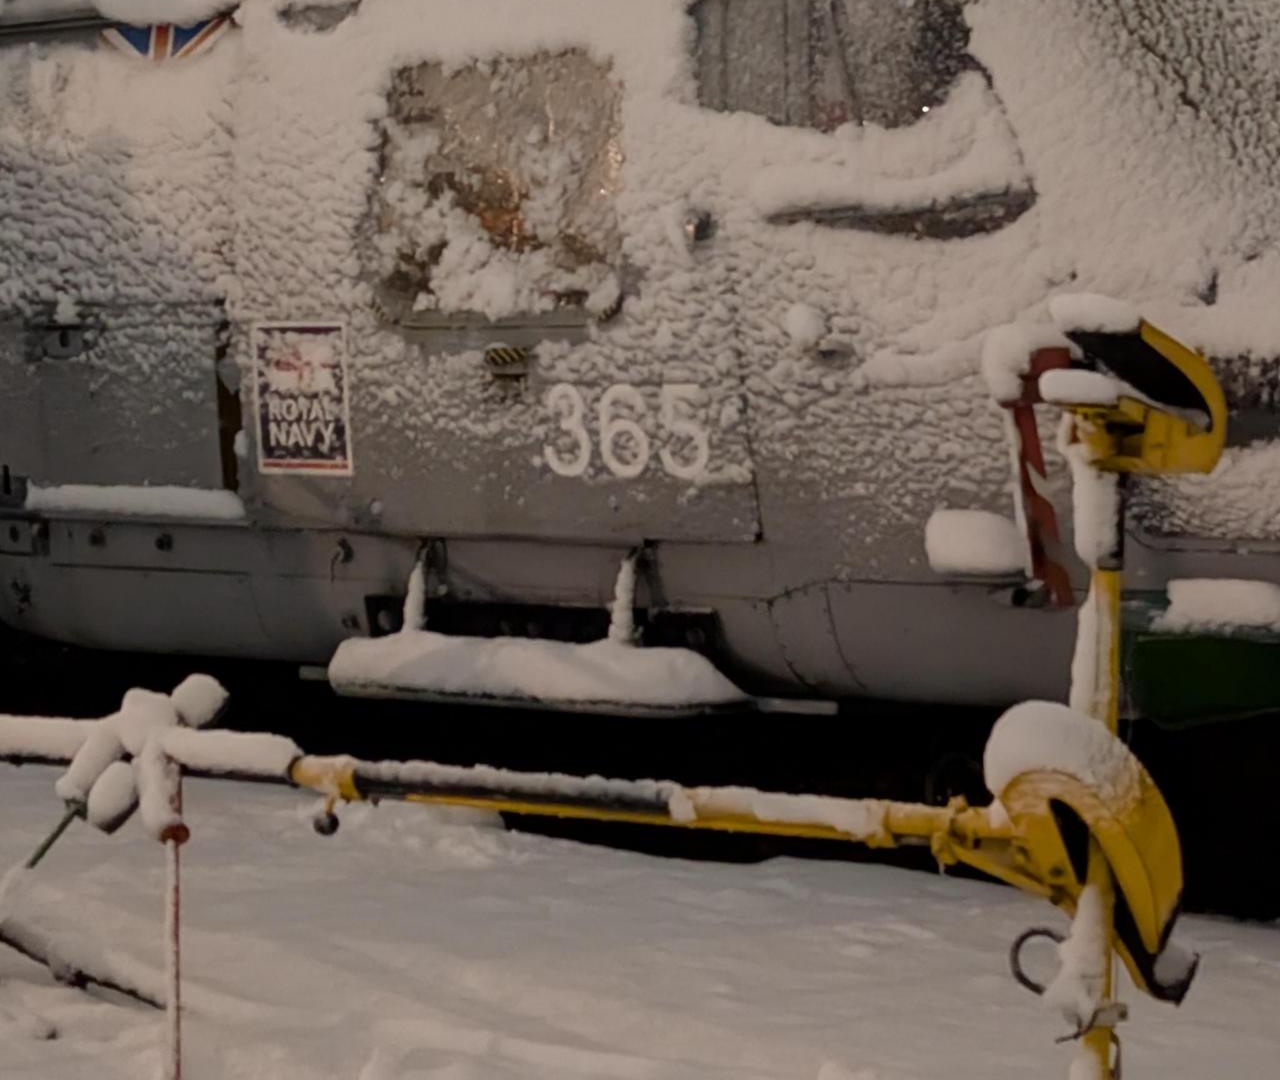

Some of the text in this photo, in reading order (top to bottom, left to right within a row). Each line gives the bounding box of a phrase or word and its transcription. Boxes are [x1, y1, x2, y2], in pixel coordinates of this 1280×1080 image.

[269, 395, 338, 420] ROYAL
[269, 421, 335, 453] NAVY
[544, 383, 709, 479] 365
